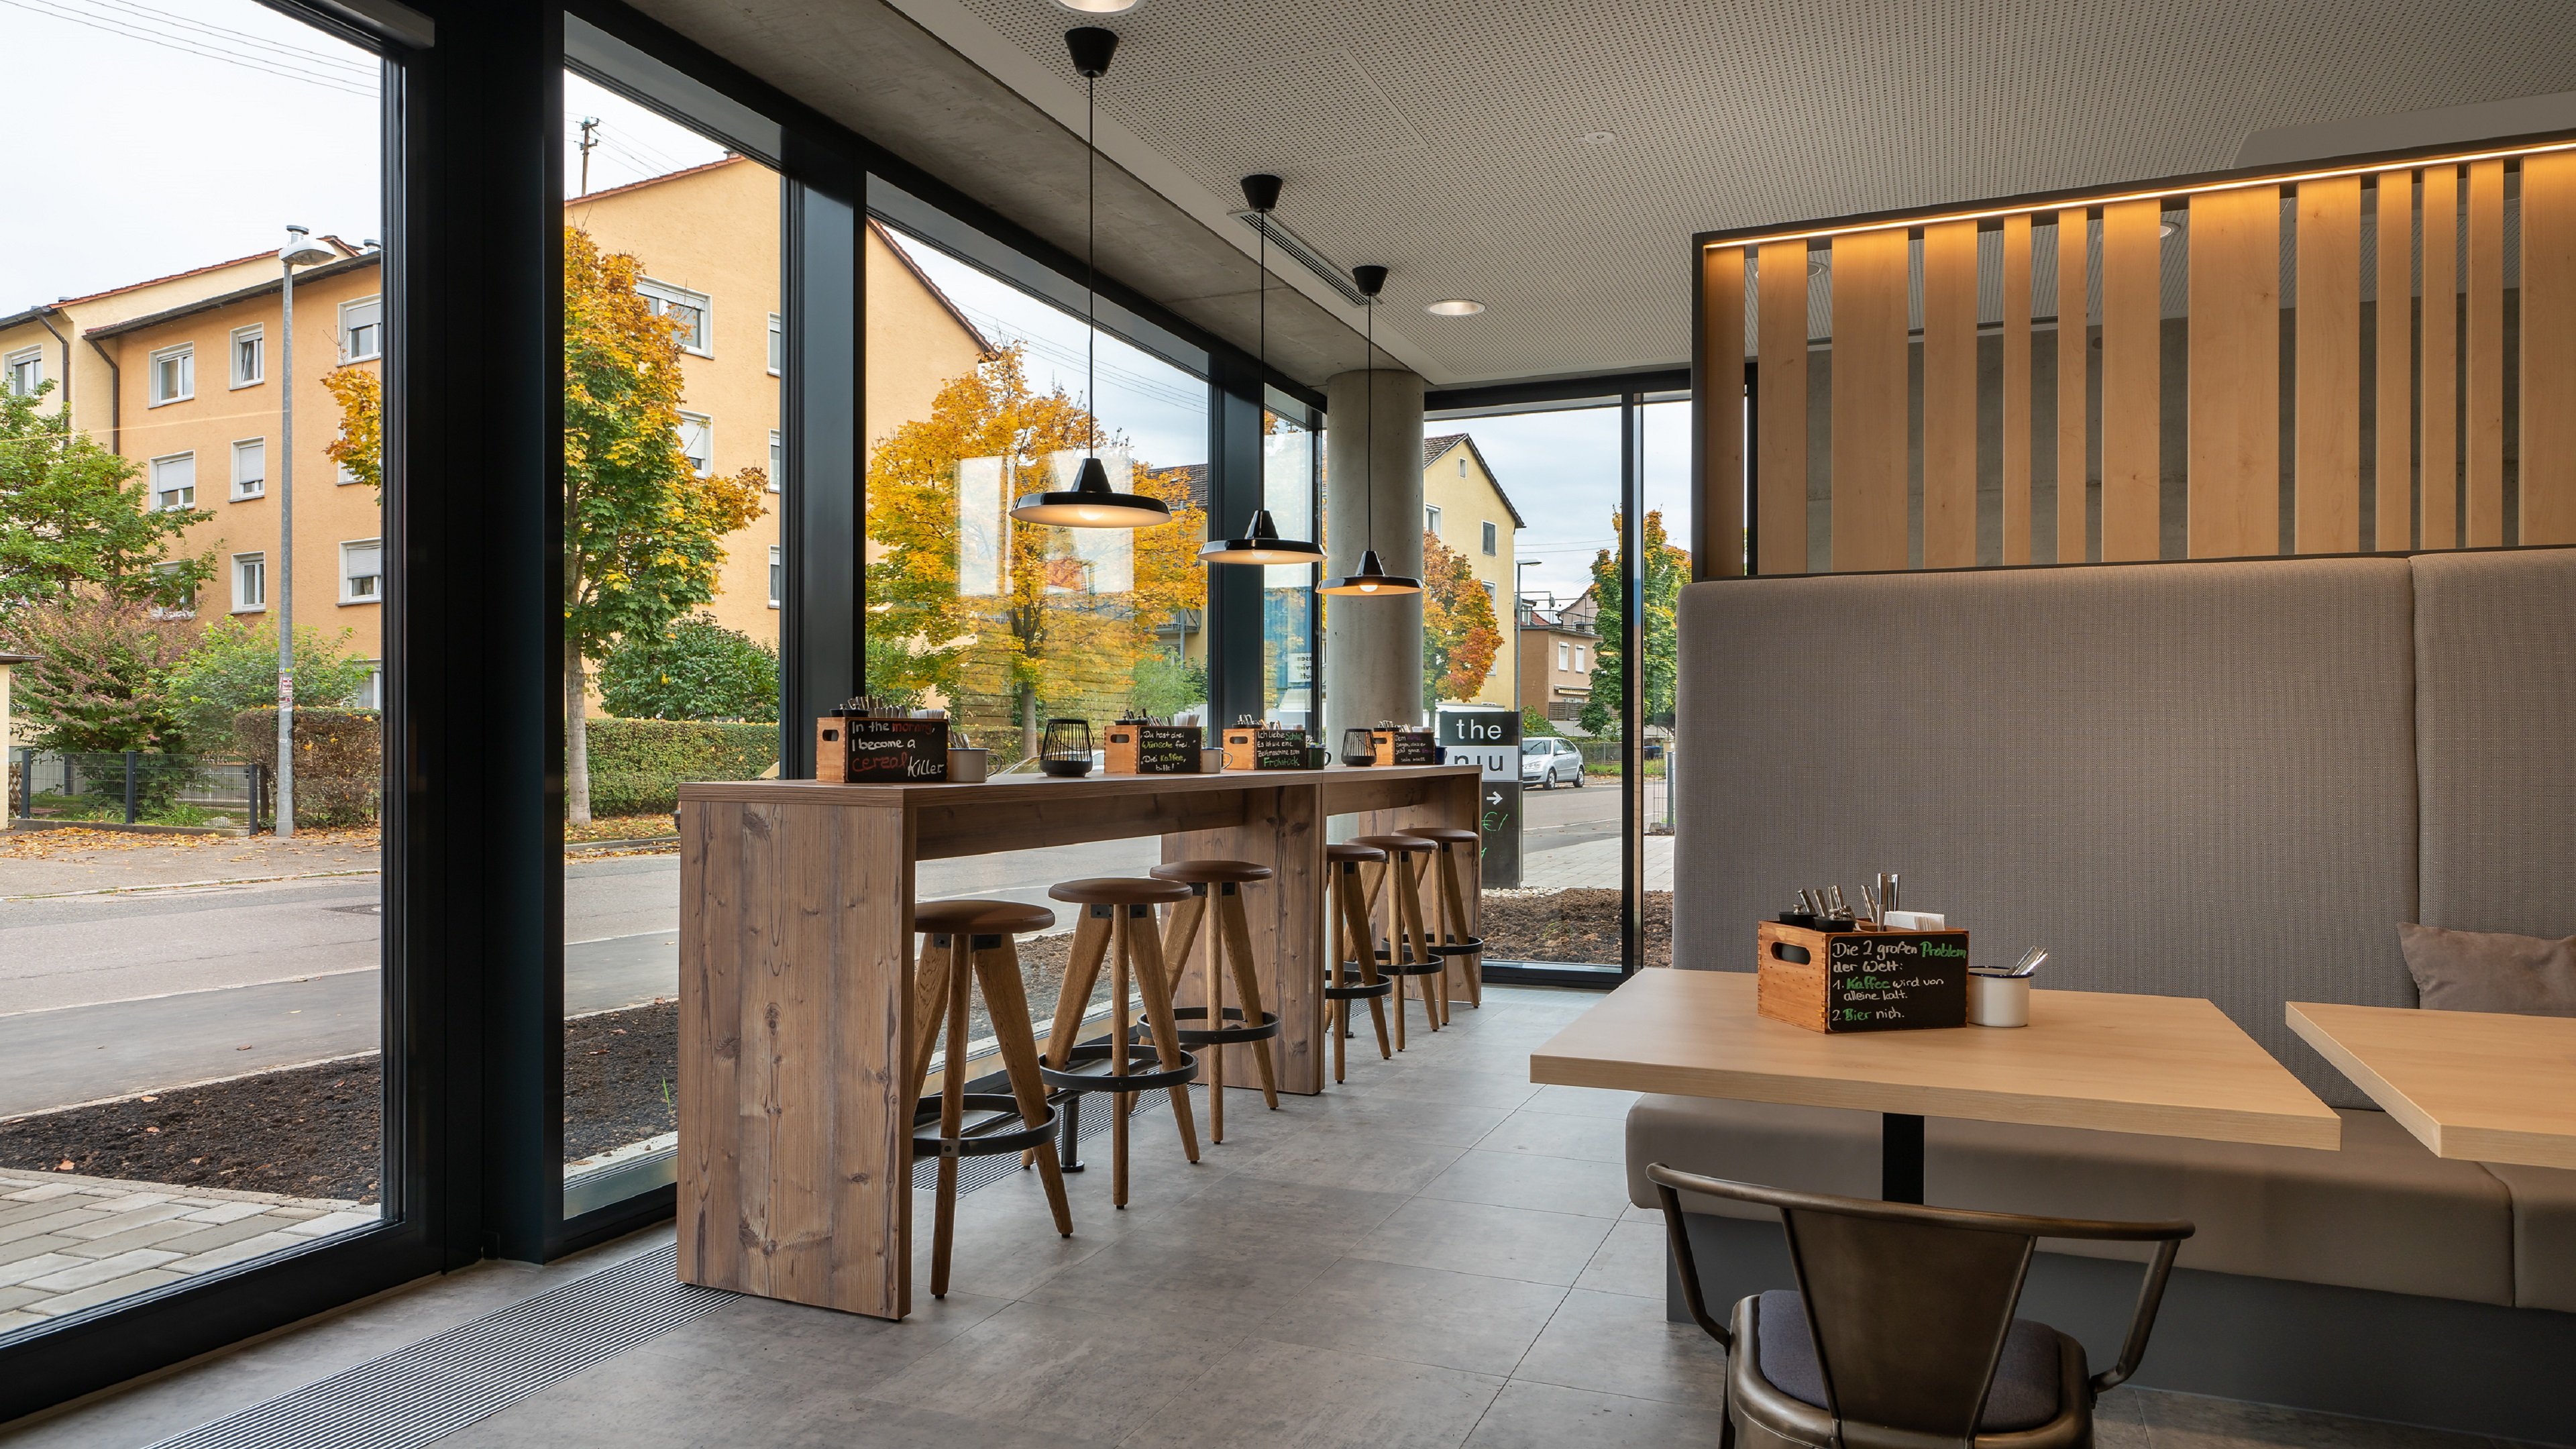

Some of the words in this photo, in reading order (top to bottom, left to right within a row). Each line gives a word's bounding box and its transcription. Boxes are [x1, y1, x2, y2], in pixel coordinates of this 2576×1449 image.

[852, 721, 864, 734] In
[868, 721, 890, 733] the
[1456, 718, 1503, 740] the
[1156, 731, 1170, 739] hast
[1257, 731, 1268, 739] Ich
[852, 739, 855, 751] I
[859, 738, 905, 751] become
[907, 739, 916, 749] a
[1141, 741, 1173, 749] Wünsche
[852, 751, 908, 772] cereal
[1832, 942, 1859, 958] Die
[1863, 940, 1872, 955] 2
[1876, 941, 1918, 961] großen
[1833, 961, 1858, 973] der
[1862, 961, 1904, 972] Welt:
[1832, 979, 1844, 989] 1.
[1846, 975, 1891, 989] Kaffee
[1892, 977, 1920, 988] wird
[1923, 978, 1944, 986] von
[1843, 990, 1880, 1001] alleine
[1882, 989, 1908, 1001] kalt.
[1832, 1010, 1841, 1021] 2.
[1843, 1008, 1872, 1021] Bier
